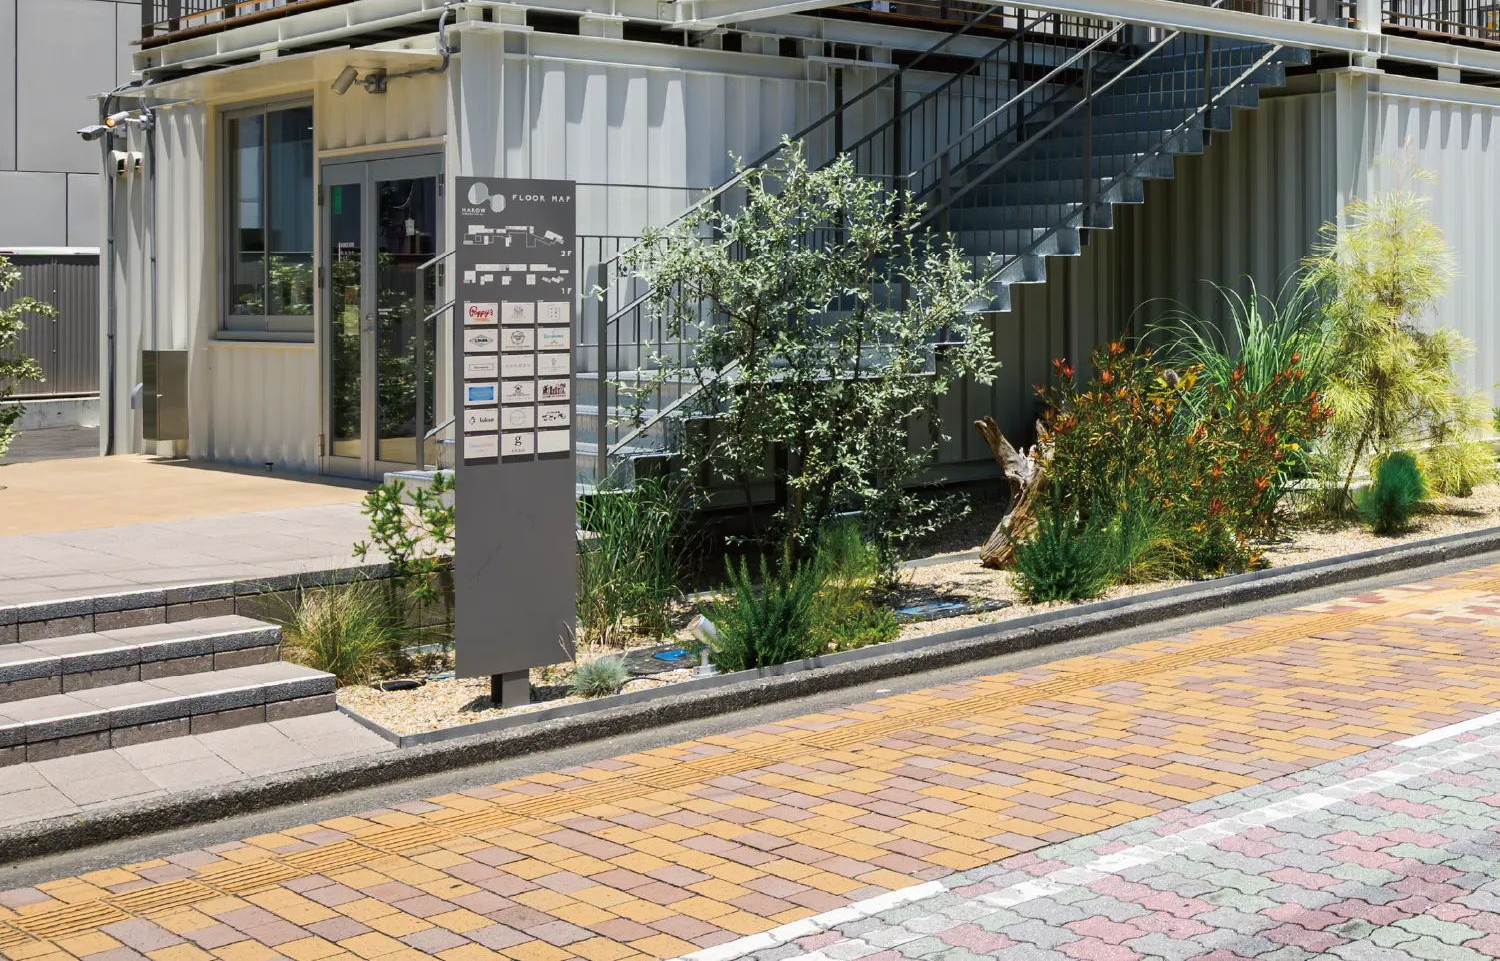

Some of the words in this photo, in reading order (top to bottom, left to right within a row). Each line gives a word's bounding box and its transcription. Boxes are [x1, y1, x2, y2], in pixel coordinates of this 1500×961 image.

[511, 194, 546, 202] FLOOR
[551, 195, 571, 203] MAP
[560, 287, 572, 295] 1F
[469, 305, 494, 318] Poppy's
